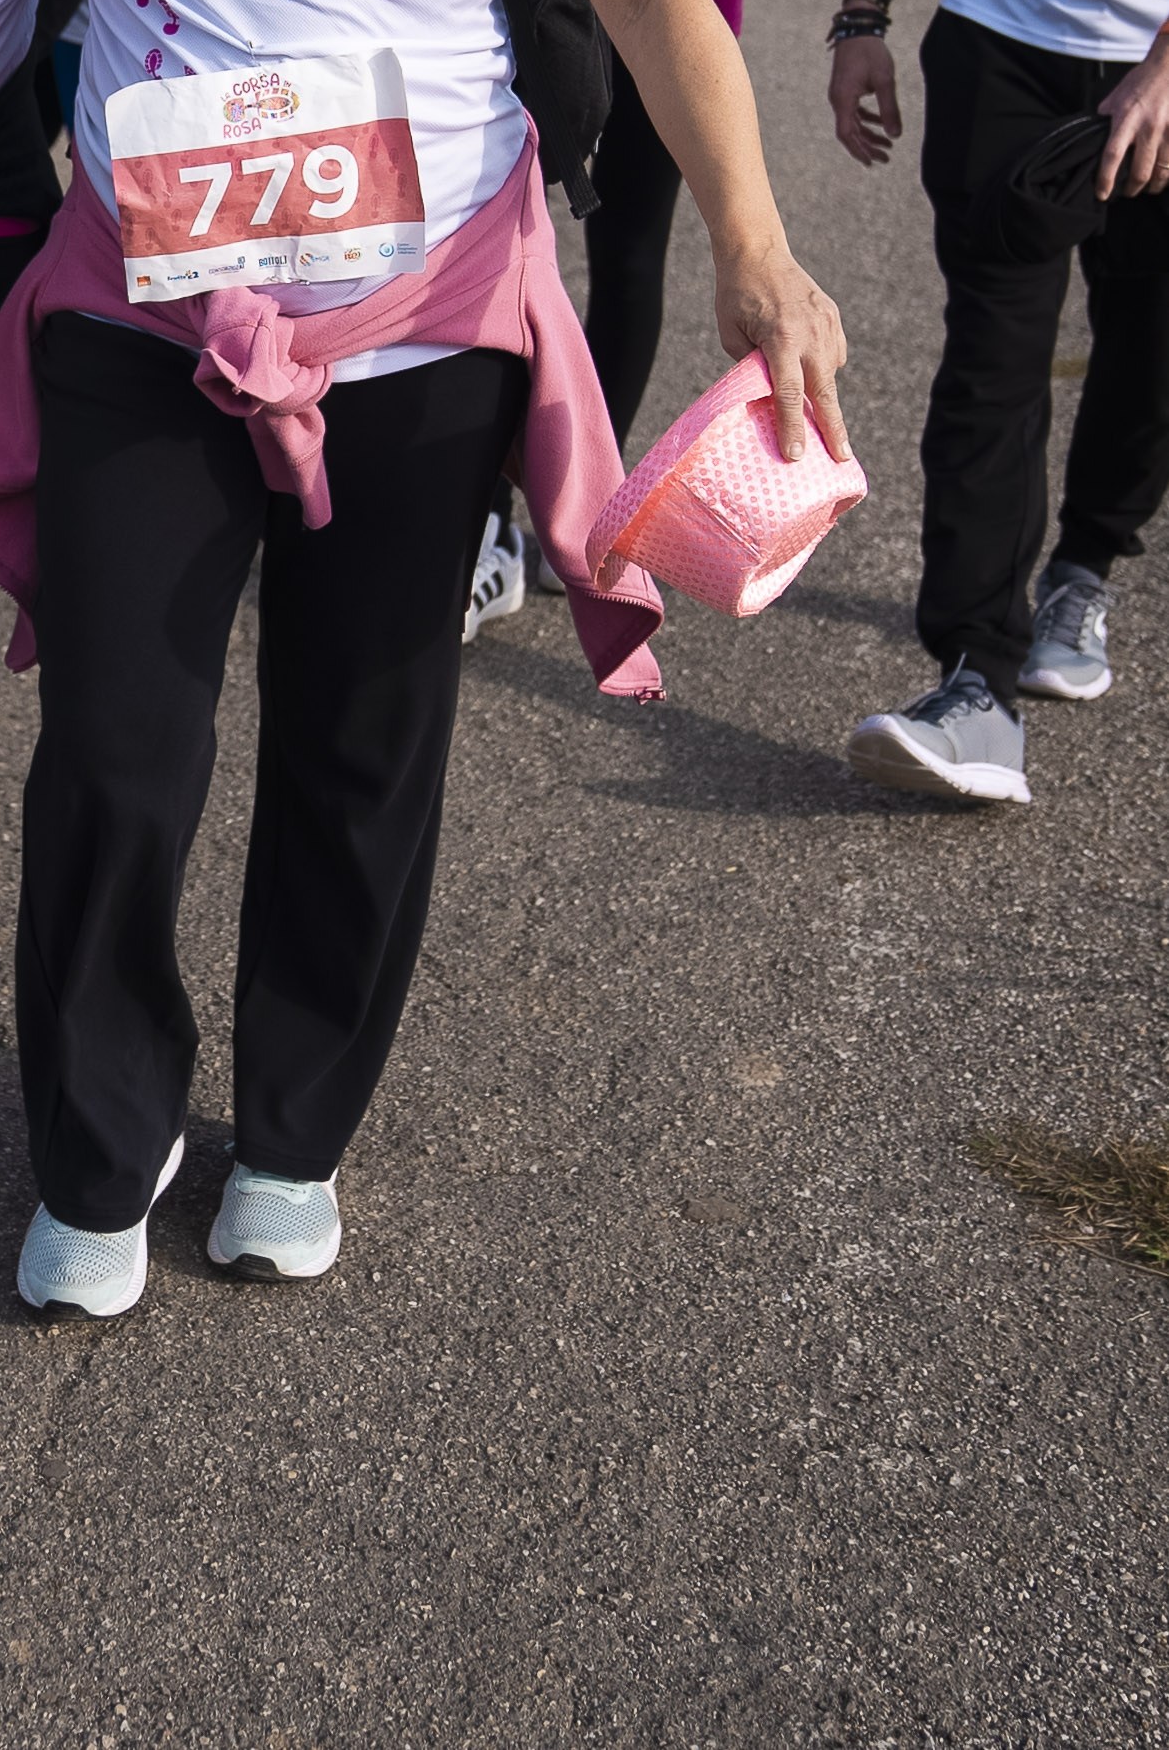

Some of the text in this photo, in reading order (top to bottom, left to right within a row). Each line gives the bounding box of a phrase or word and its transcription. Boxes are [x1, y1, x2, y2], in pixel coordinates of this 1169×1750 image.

[220, 92, 231, 102] LA
[232, 72, 280, 96] CORSA
[223, 117, 262, 139] ROSA
[178, 144, 359, 238] 779
